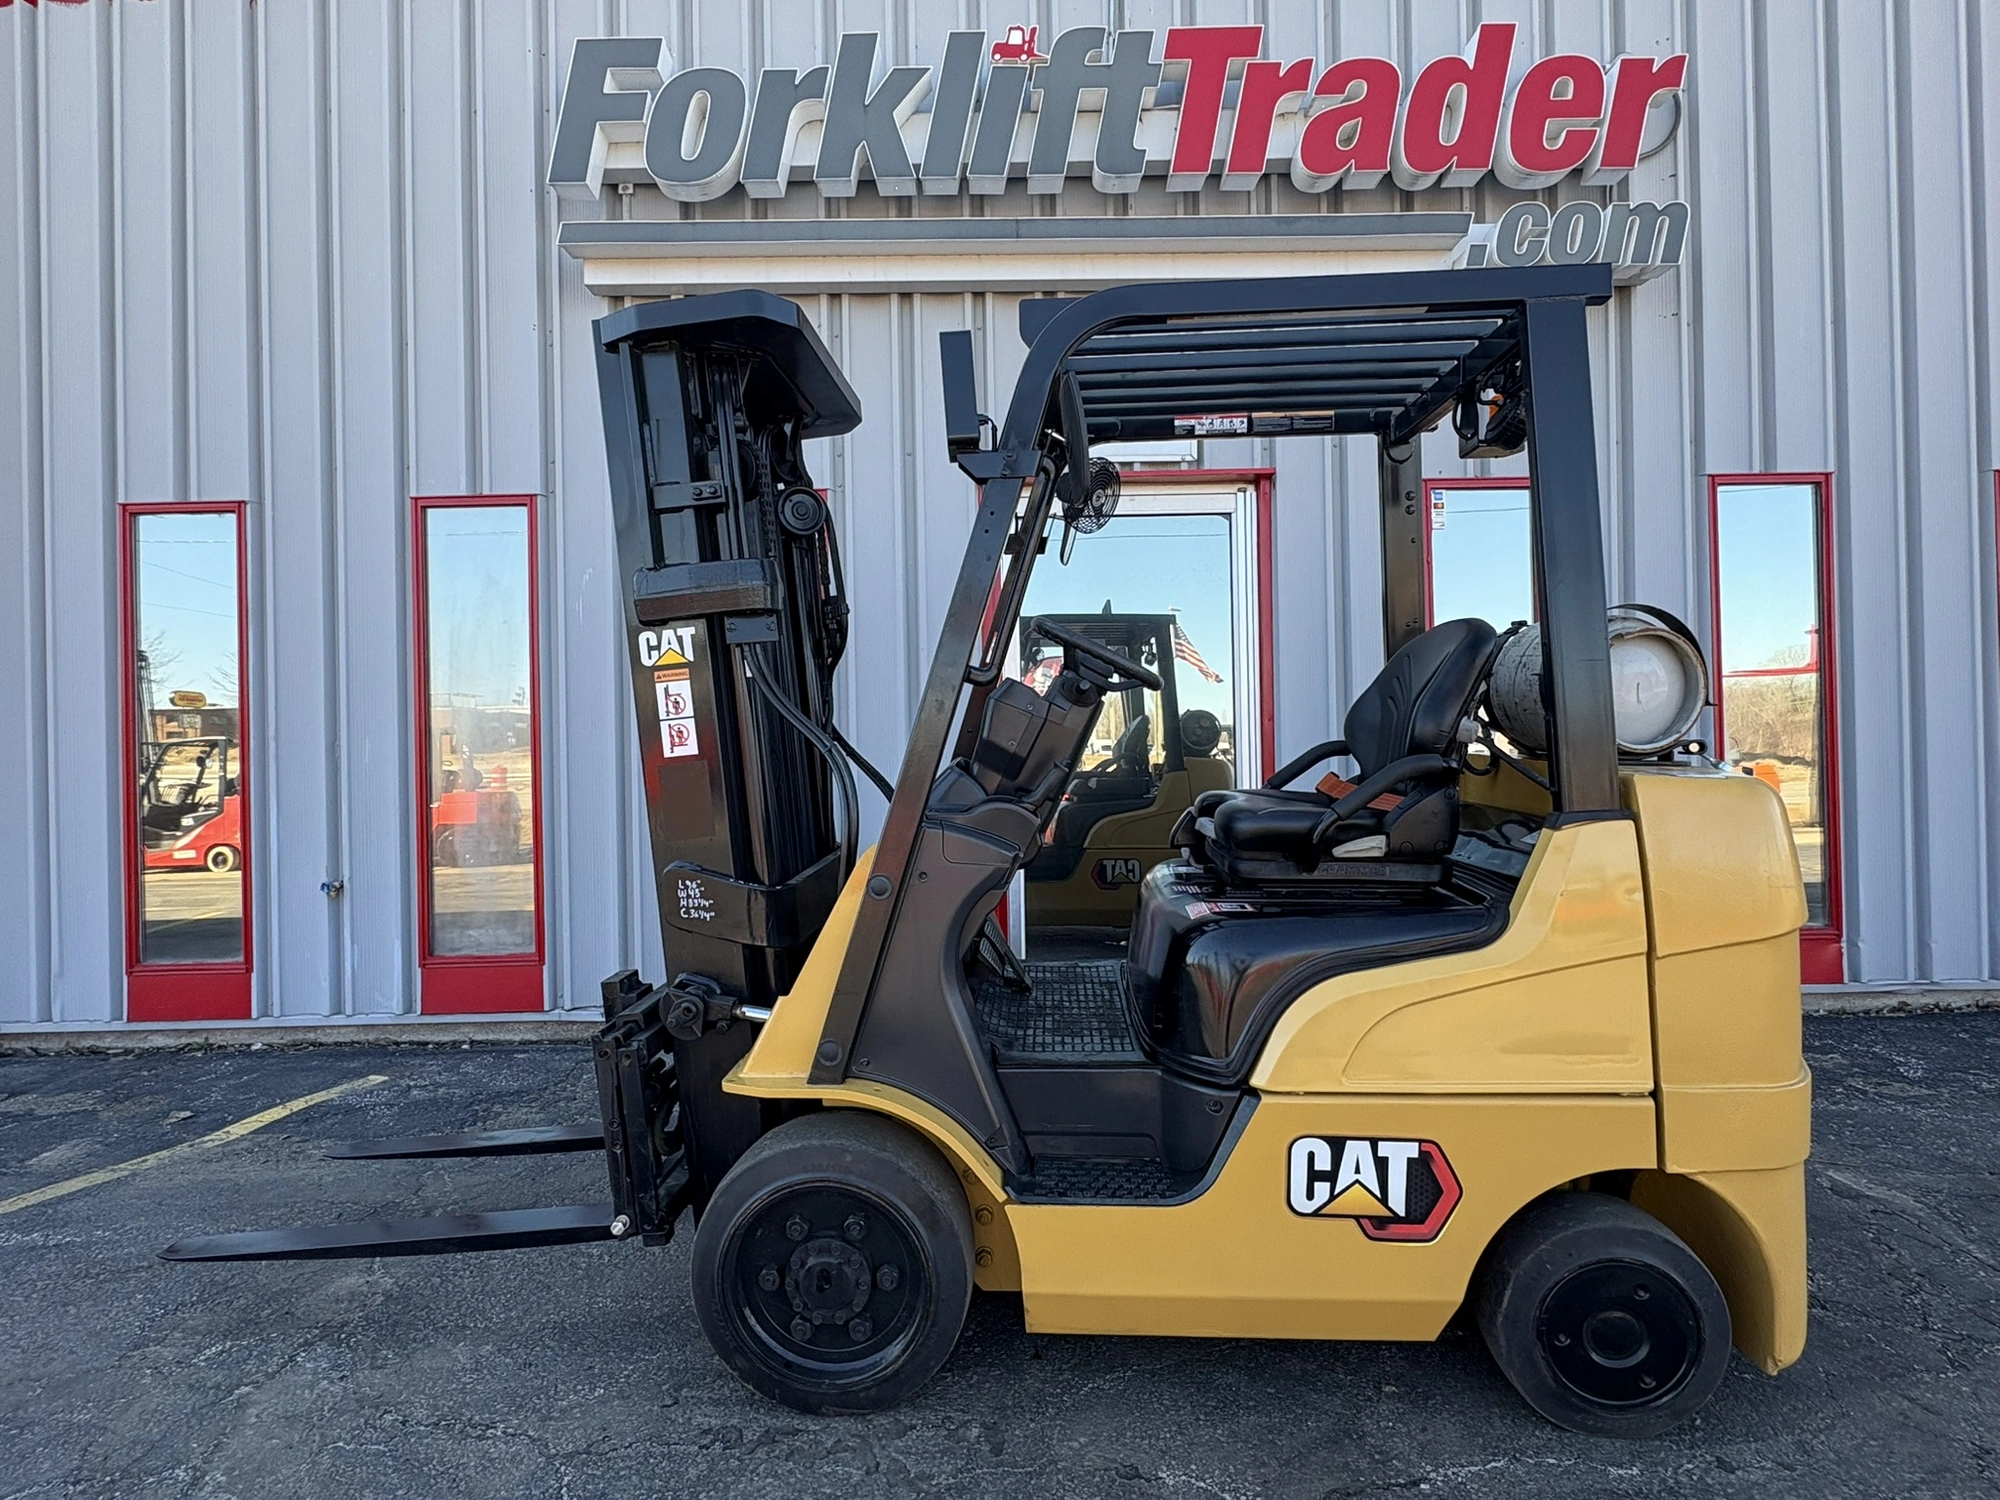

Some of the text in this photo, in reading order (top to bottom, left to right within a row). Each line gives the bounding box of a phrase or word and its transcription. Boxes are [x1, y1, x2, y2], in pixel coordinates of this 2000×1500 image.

[547, 22, 1689, 190] ForkliftTrader
[1466, 200, 1690, 268] .com
[638, 626, 696, 667] CAT
[662, 671, 689, 679] WARNING
[1317, 864, 1388, 877] GRAMMER
[678, 879, 685, 889] L
[677, 889, 687, 898] W
[679, 898, 687, 907] H
[680, 907, 689, 918] C
[1290, 1137, 1419, 1217] CAT
